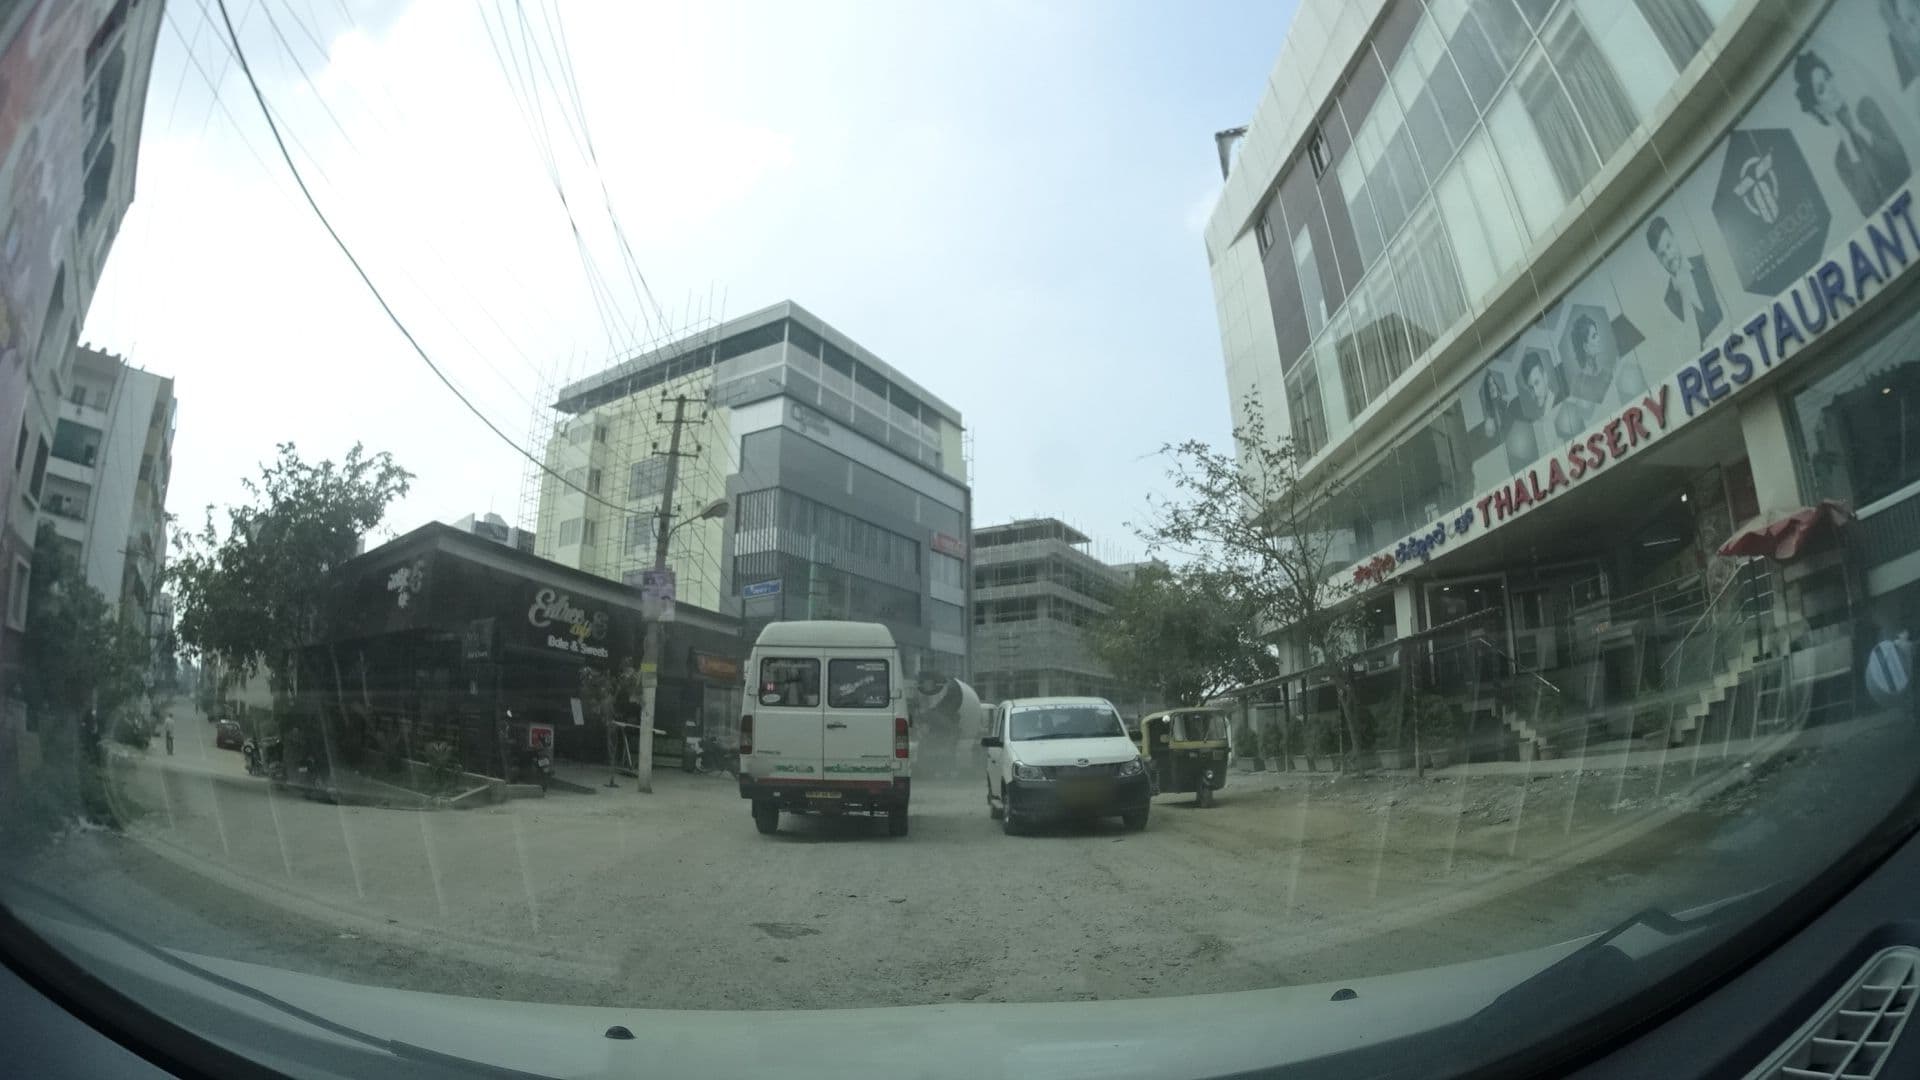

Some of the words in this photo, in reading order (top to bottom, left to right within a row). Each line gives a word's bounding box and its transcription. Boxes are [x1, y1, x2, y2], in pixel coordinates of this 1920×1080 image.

[1477, 385, 1671, 528] THALASSERY
[1676, 190, 1920, 416] RESTAURANT
[580, 642, 609, 658] Sweets
